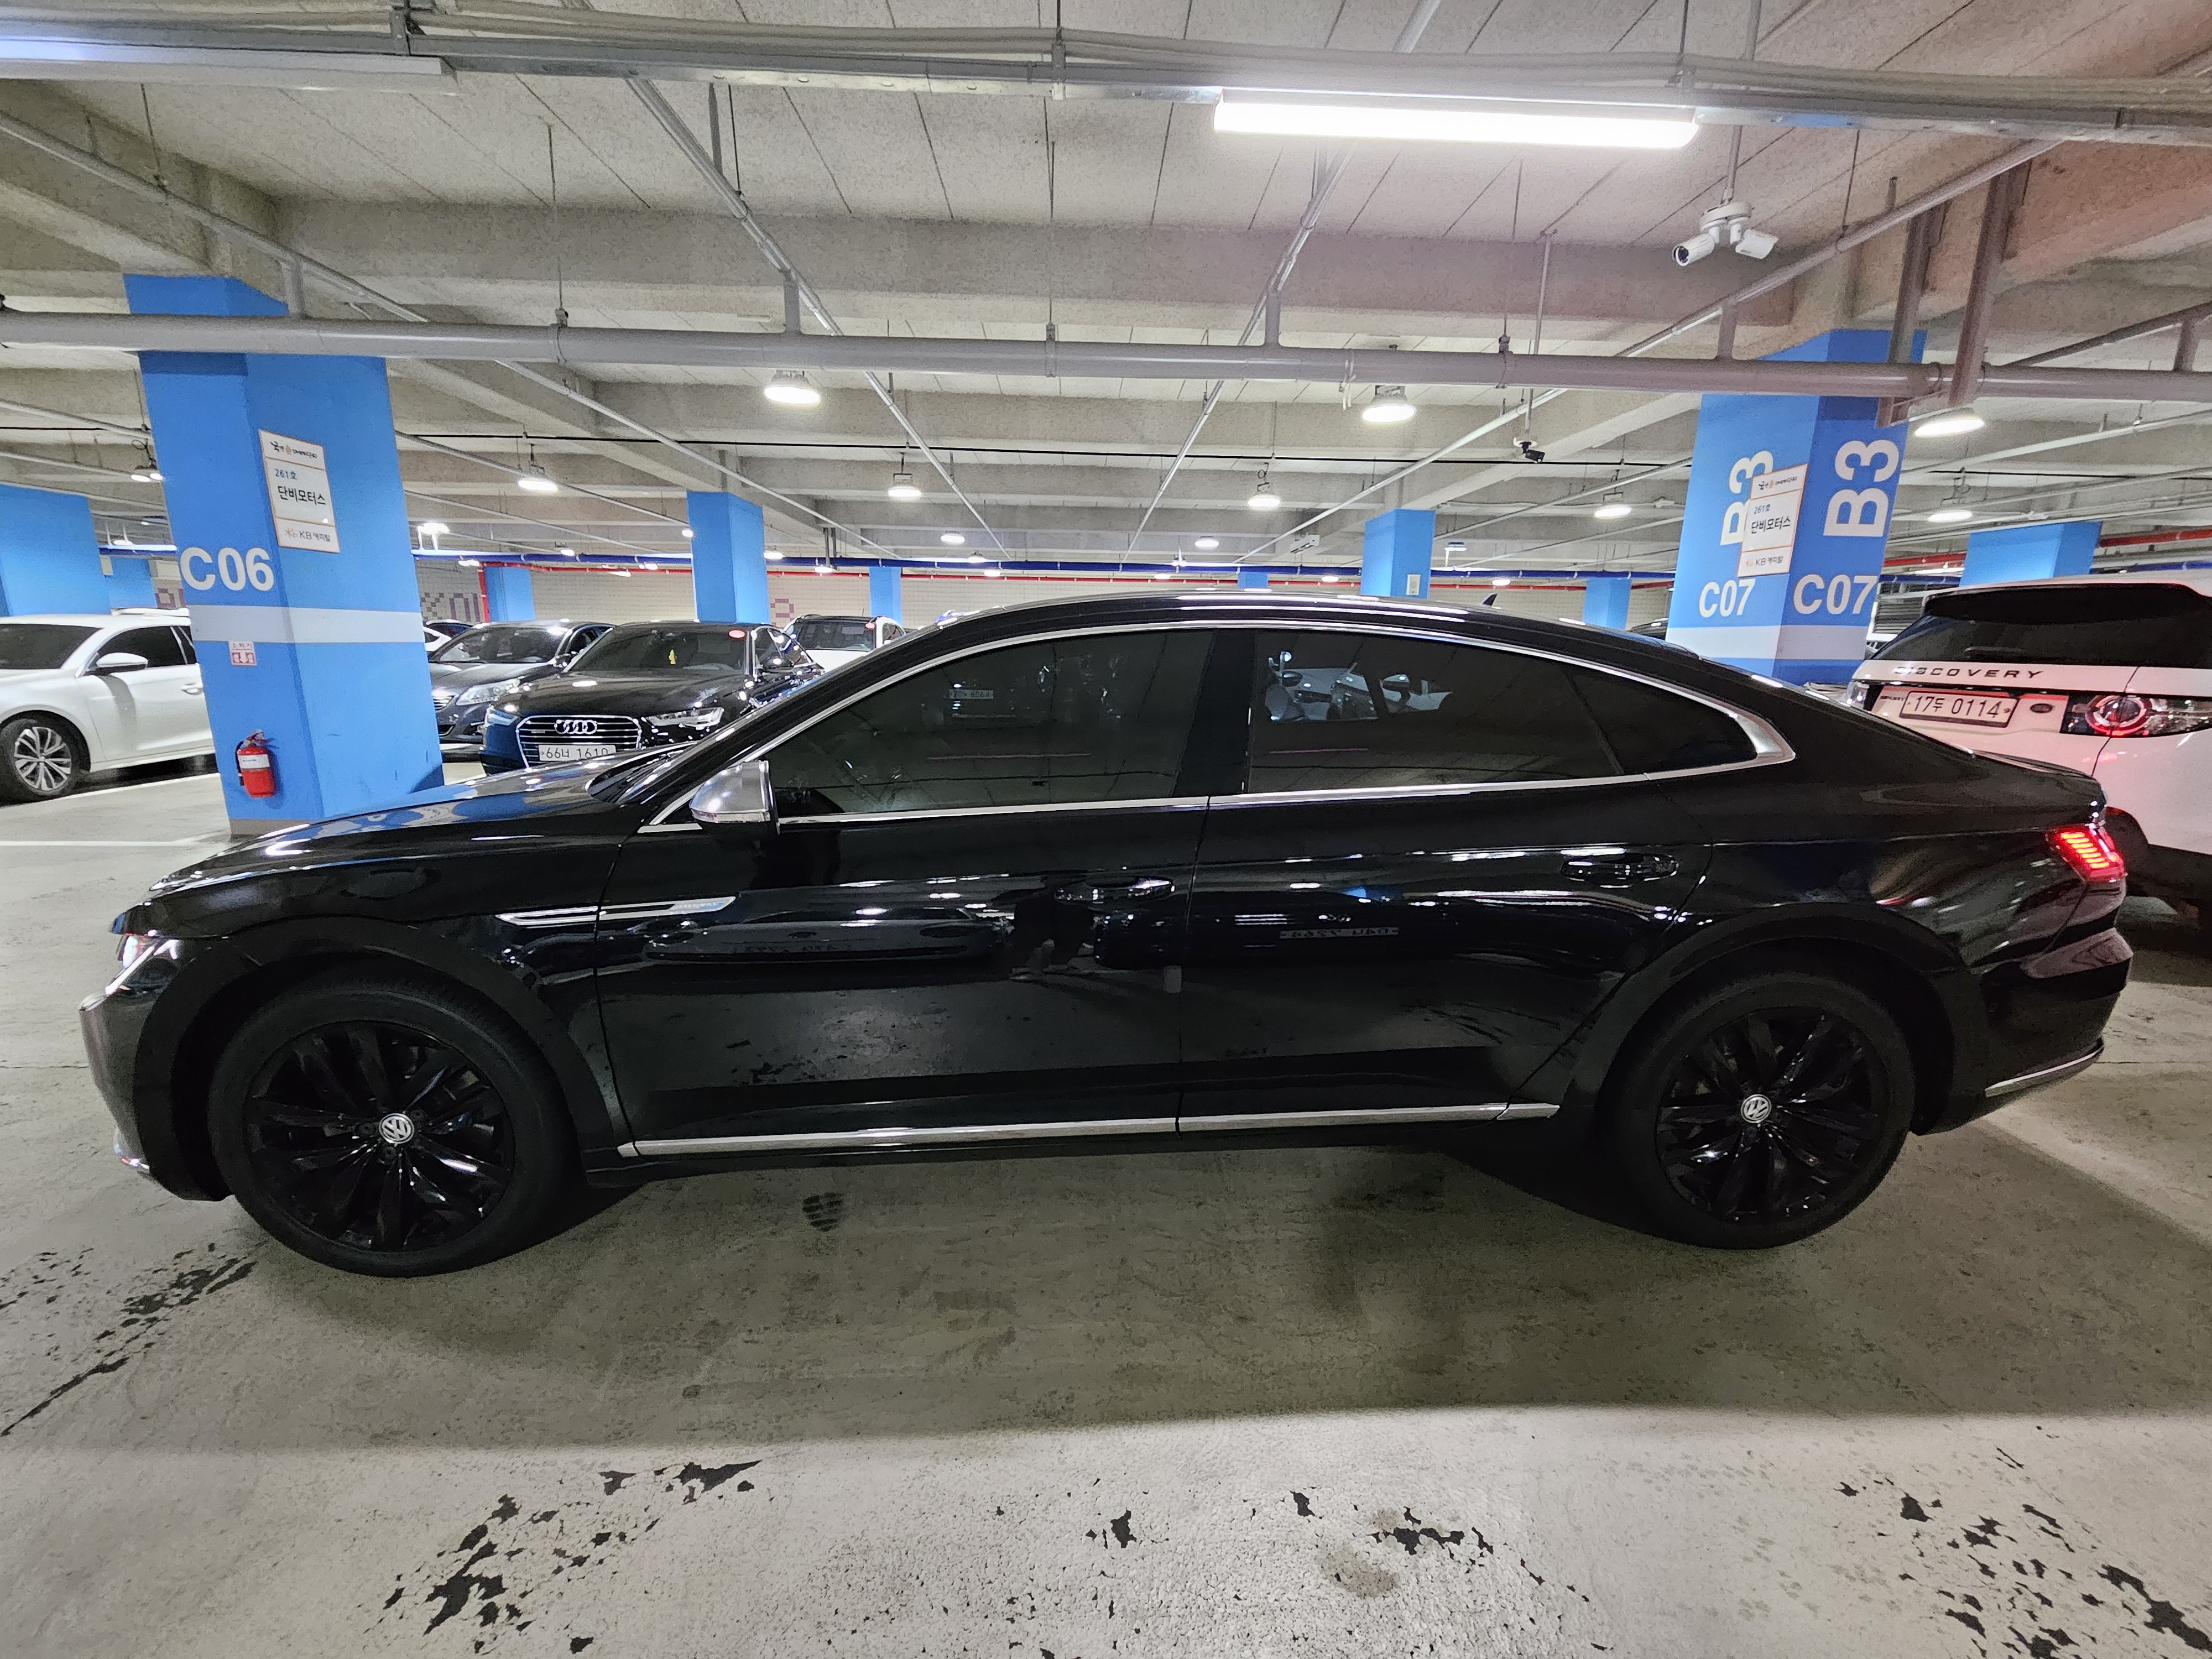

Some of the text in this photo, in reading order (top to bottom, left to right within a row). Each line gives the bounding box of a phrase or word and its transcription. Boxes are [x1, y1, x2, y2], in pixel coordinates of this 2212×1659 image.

[277, 486, 326, 505] 단비모터스
[1824, 439, 1900, 538] B3
[299, 530, 312, 540] KB
[1751, 516, 1791, 534] 단비모터스
[180, 547, 274, 591] C06
[1699, 578, 1756, 618] C07
[1793, 573, 1879, 614] C07
[1914, 695, 2002, 718] 17두 0114
[546, 747, 570, 759] 66너
